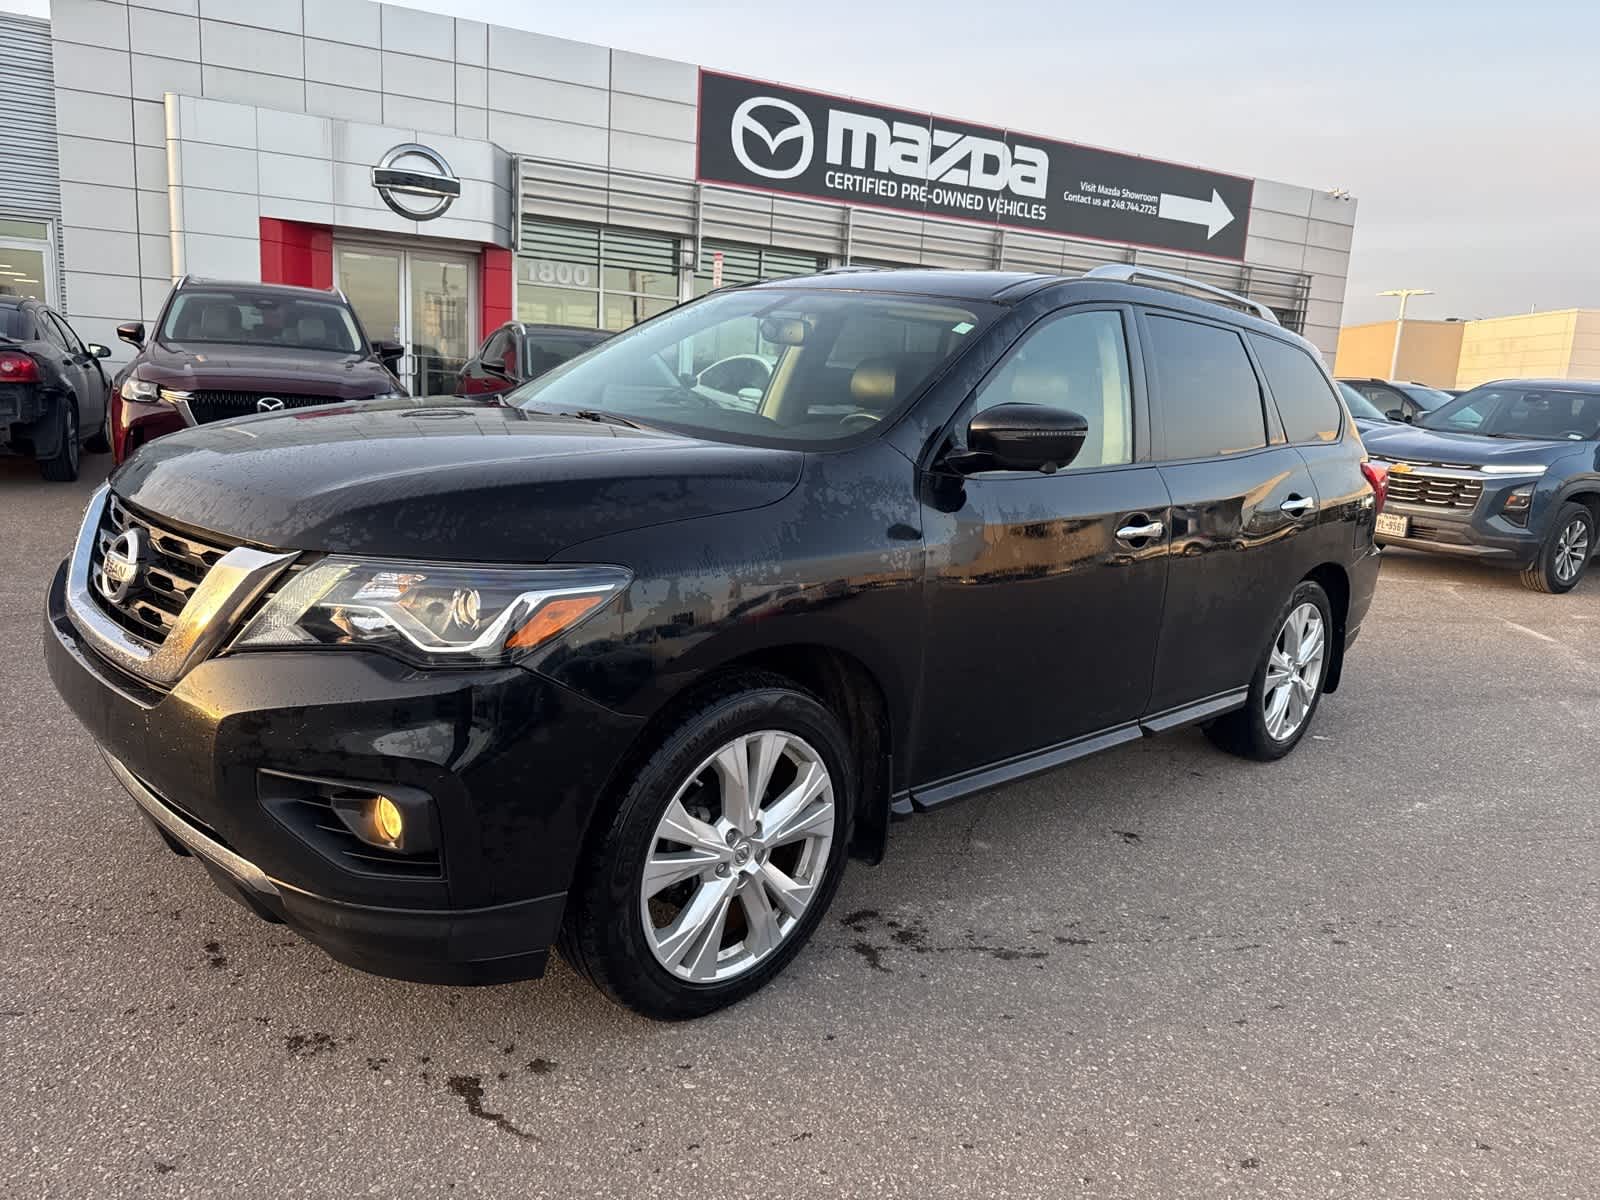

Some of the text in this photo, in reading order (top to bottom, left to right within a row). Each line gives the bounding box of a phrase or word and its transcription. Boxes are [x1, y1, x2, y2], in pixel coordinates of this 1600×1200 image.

[825, 171, 1046, 220] CERTIFIED PRE-OWNED VEHICLES
[1063, 191, 1157, 215] Contact us at 248.744.2725
[1080, 181, 1159, 203] Visit Mazda Showroom
[528, 262, 589, 285] 1800
